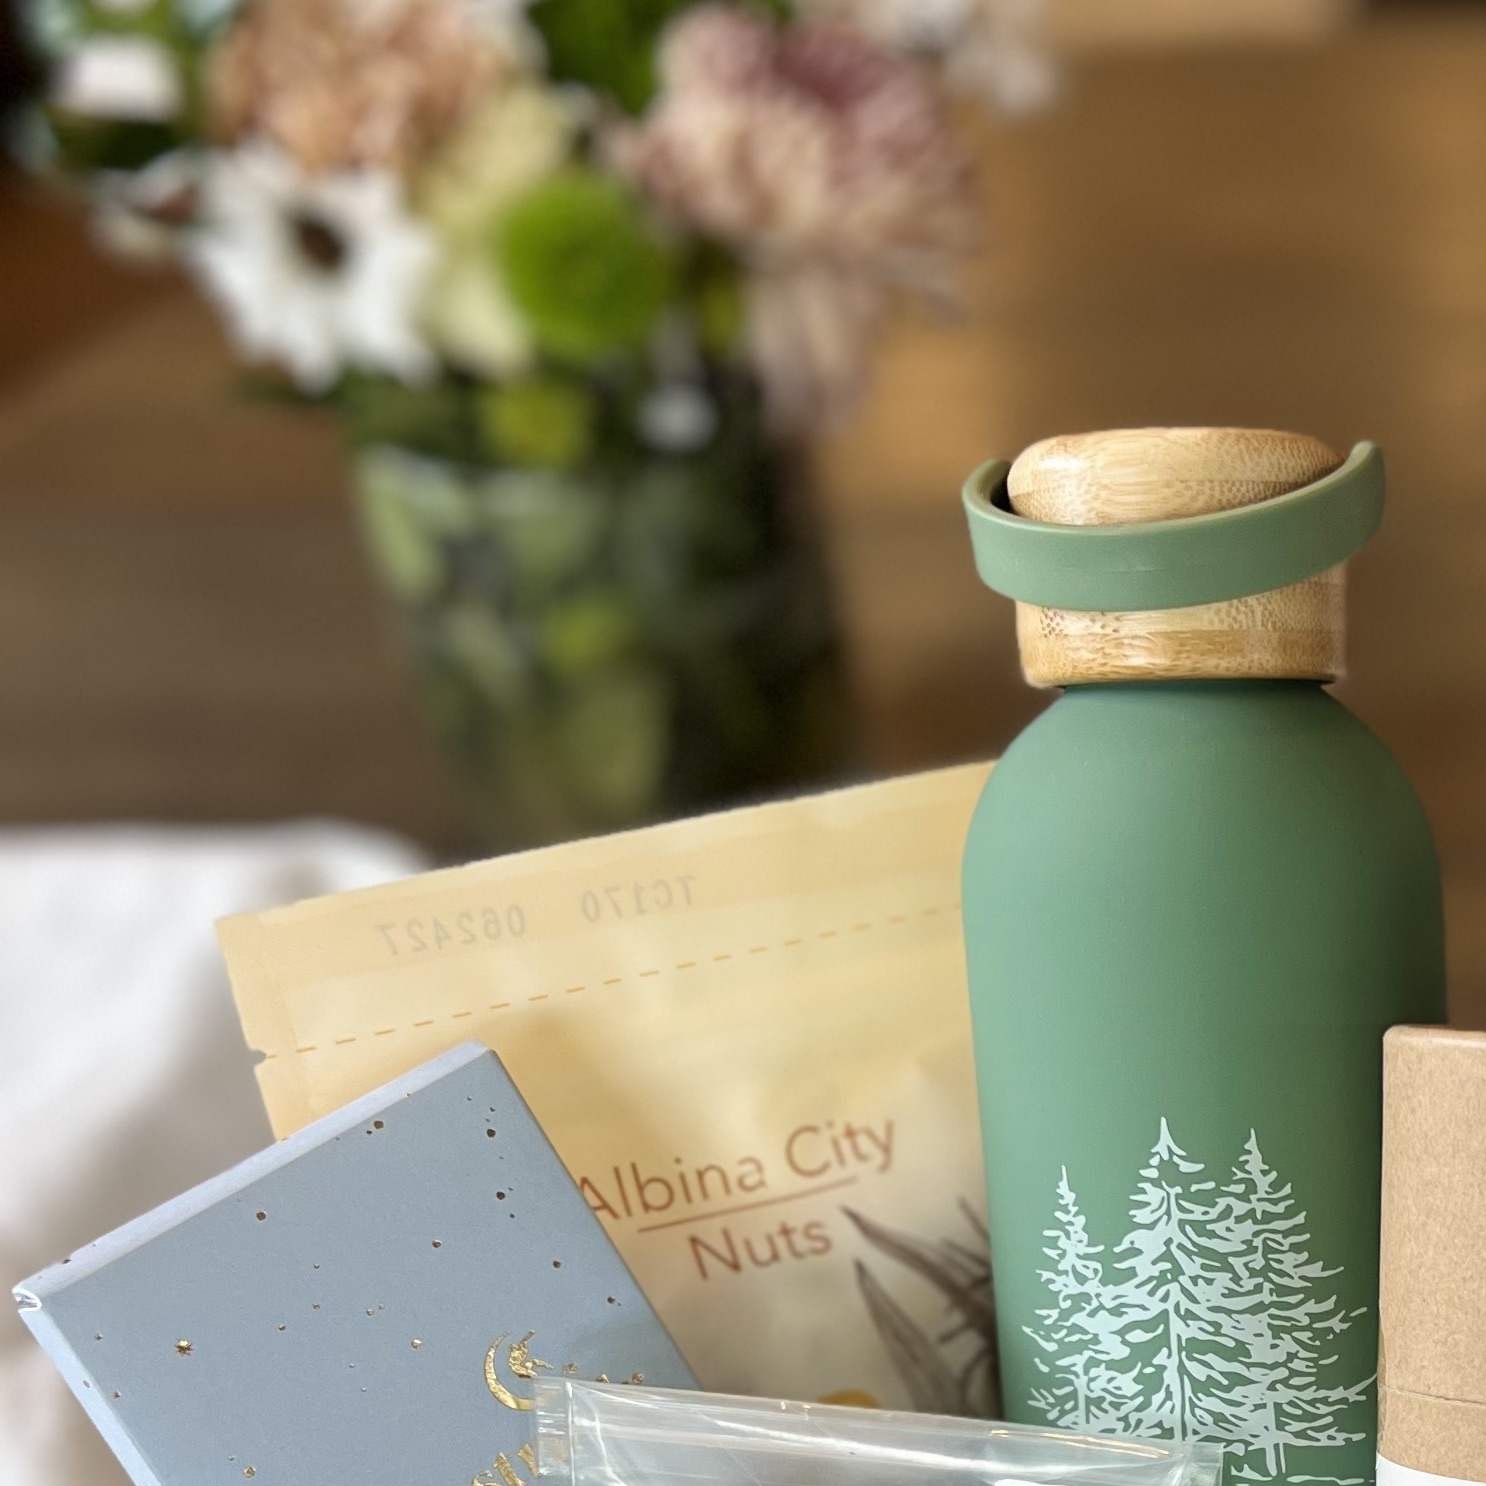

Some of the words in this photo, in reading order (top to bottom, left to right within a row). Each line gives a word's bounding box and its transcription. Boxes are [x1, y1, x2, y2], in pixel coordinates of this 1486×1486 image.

[579, 1157, 767, 1220] Albina
[785, 1120, 894, 1178] City
[688, 1220, 833, 1280] Nuts
